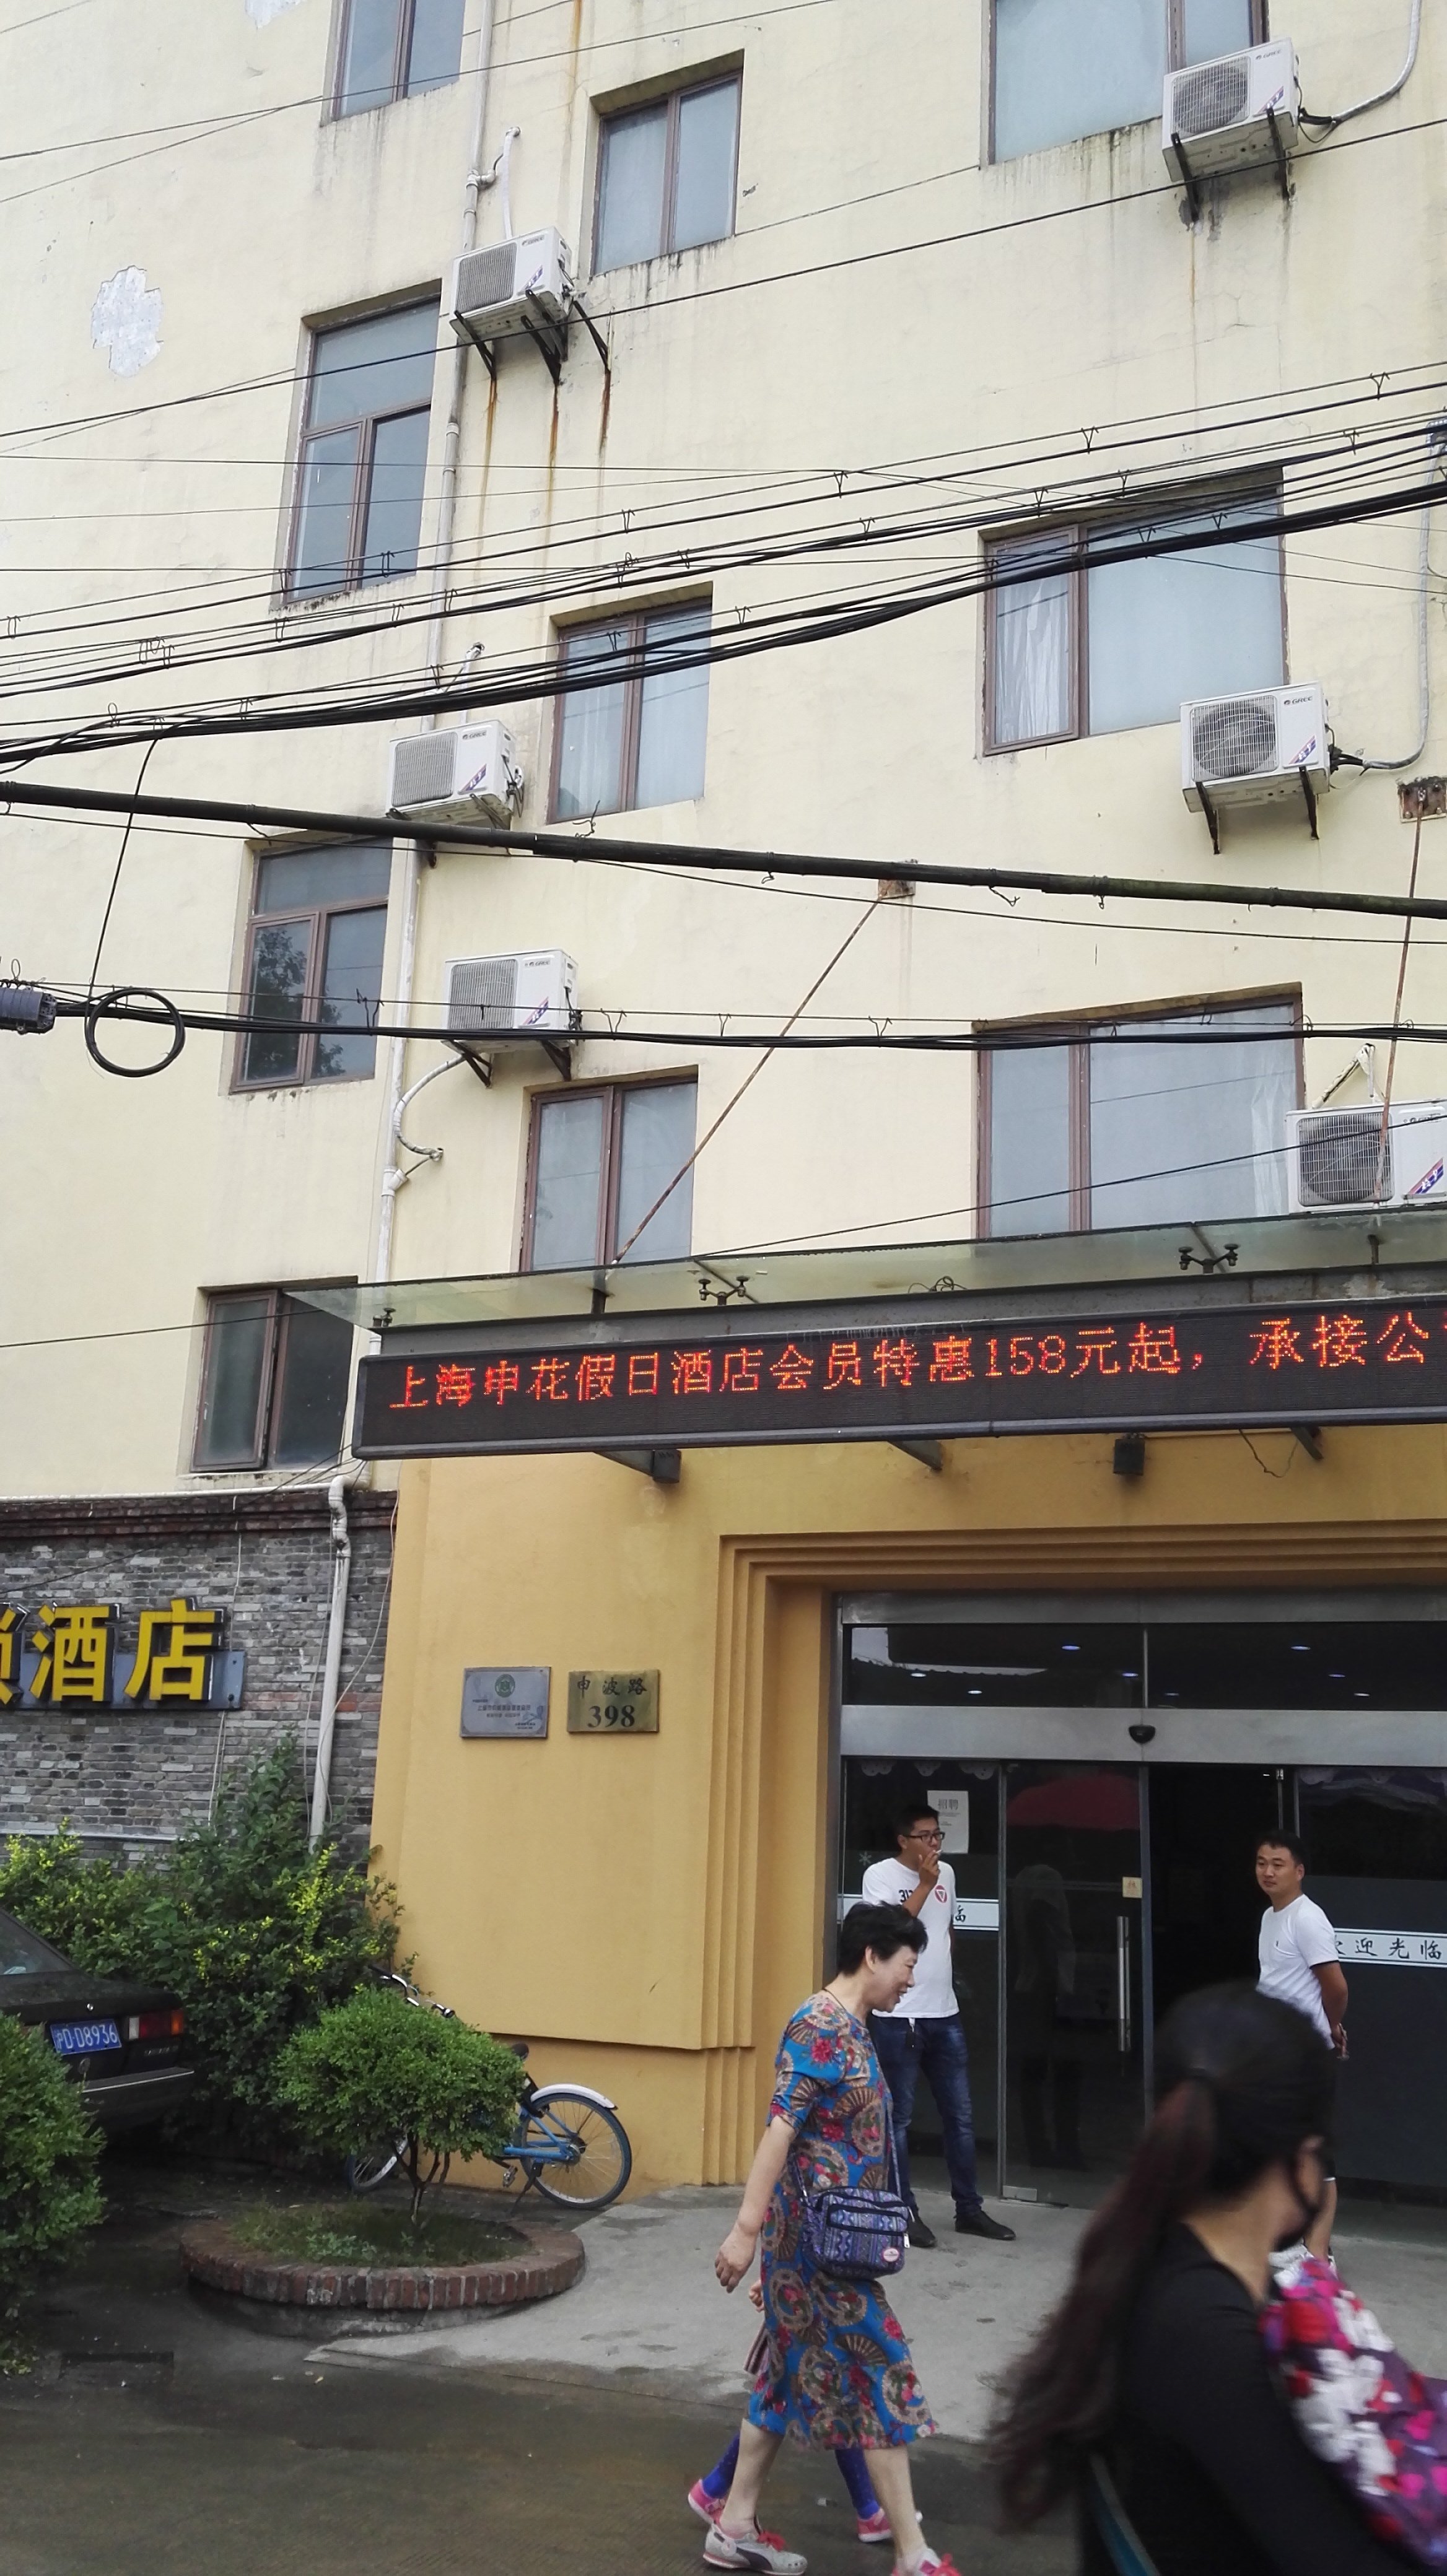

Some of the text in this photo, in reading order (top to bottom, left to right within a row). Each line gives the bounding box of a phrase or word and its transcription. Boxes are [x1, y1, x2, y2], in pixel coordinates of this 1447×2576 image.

[389, 1311, 1447, 1409] 上海申花假日酒店会员特惠158元起，承接公
[588, 1705, 636, 1728] 398
